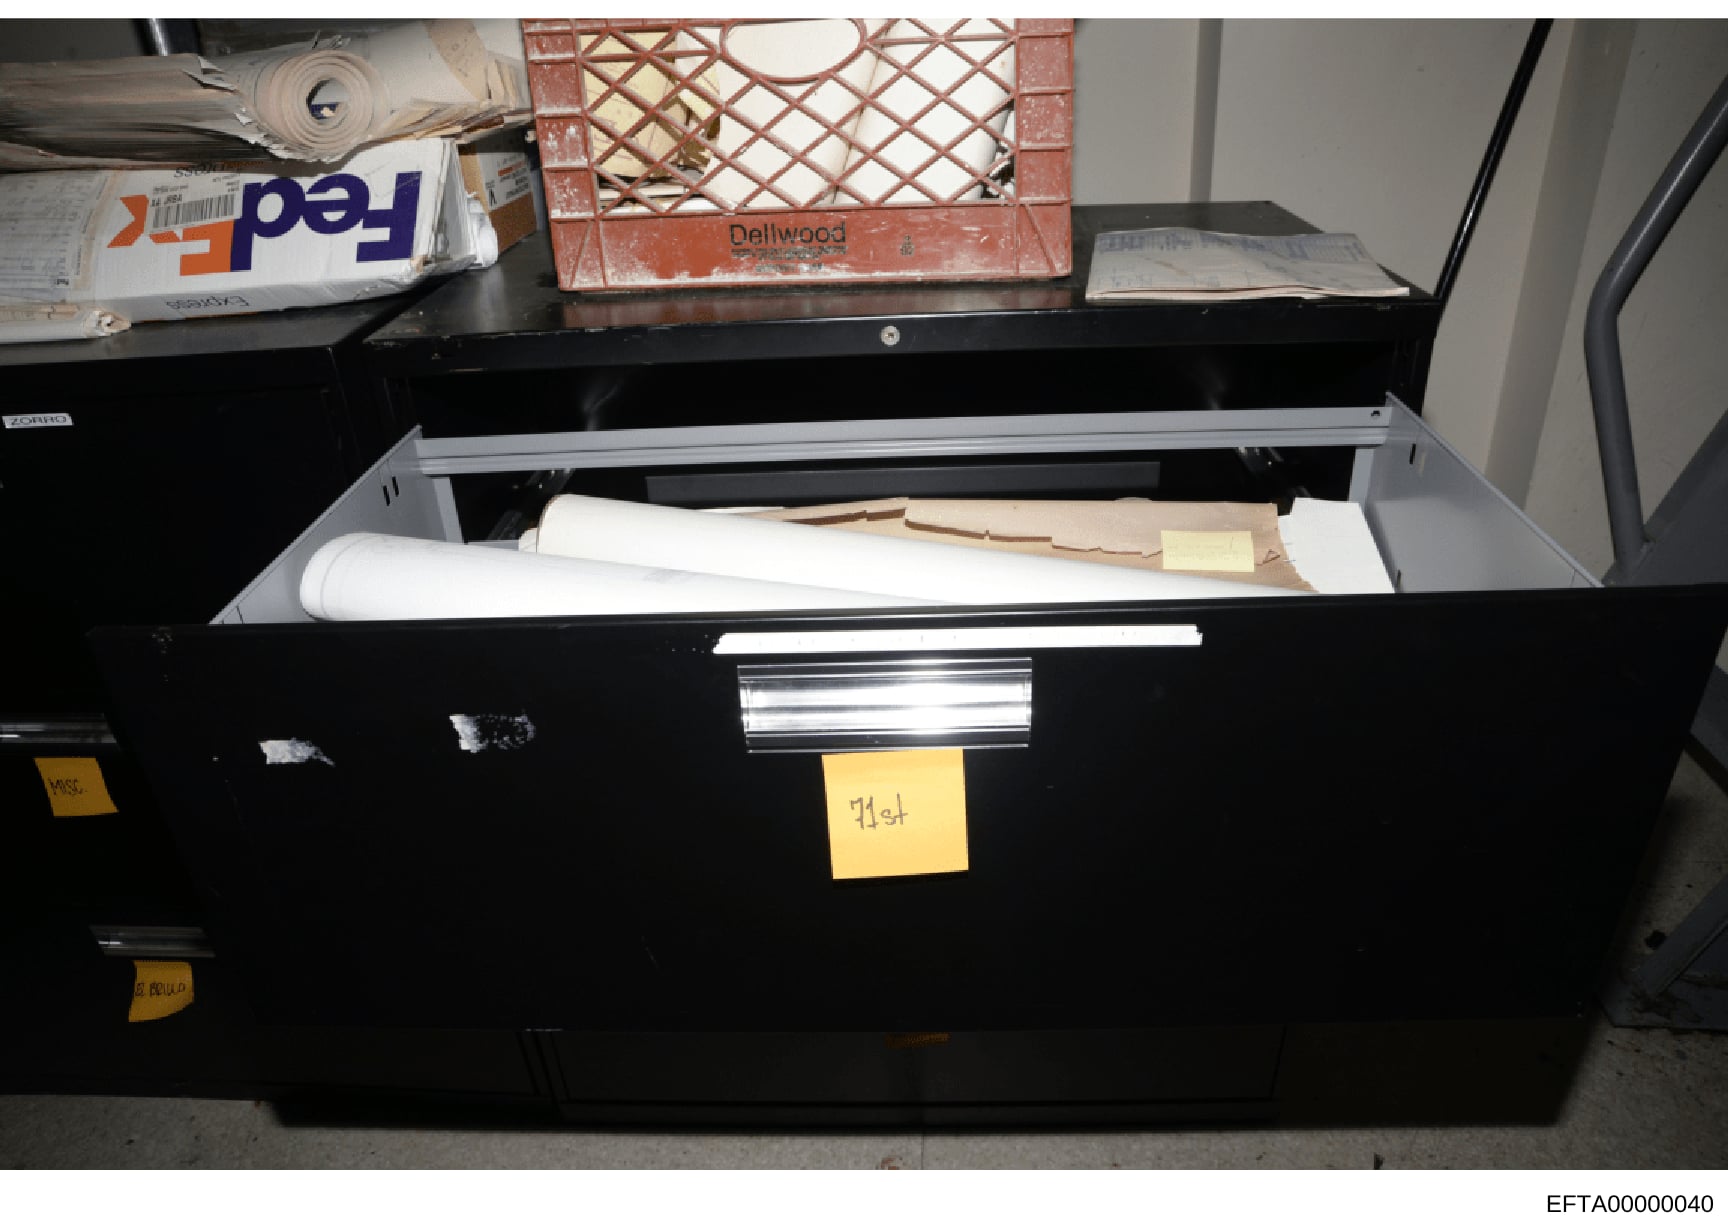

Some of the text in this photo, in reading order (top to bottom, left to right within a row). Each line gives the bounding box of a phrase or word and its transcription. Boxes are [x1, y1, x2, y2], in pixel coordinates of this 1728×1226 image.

[107, 171, 423, 277] FedEx
[729, 221, 847, 246] Dellwood
[165, 295, 249, 310] Express
[848, 792, 909, 830] 71st
